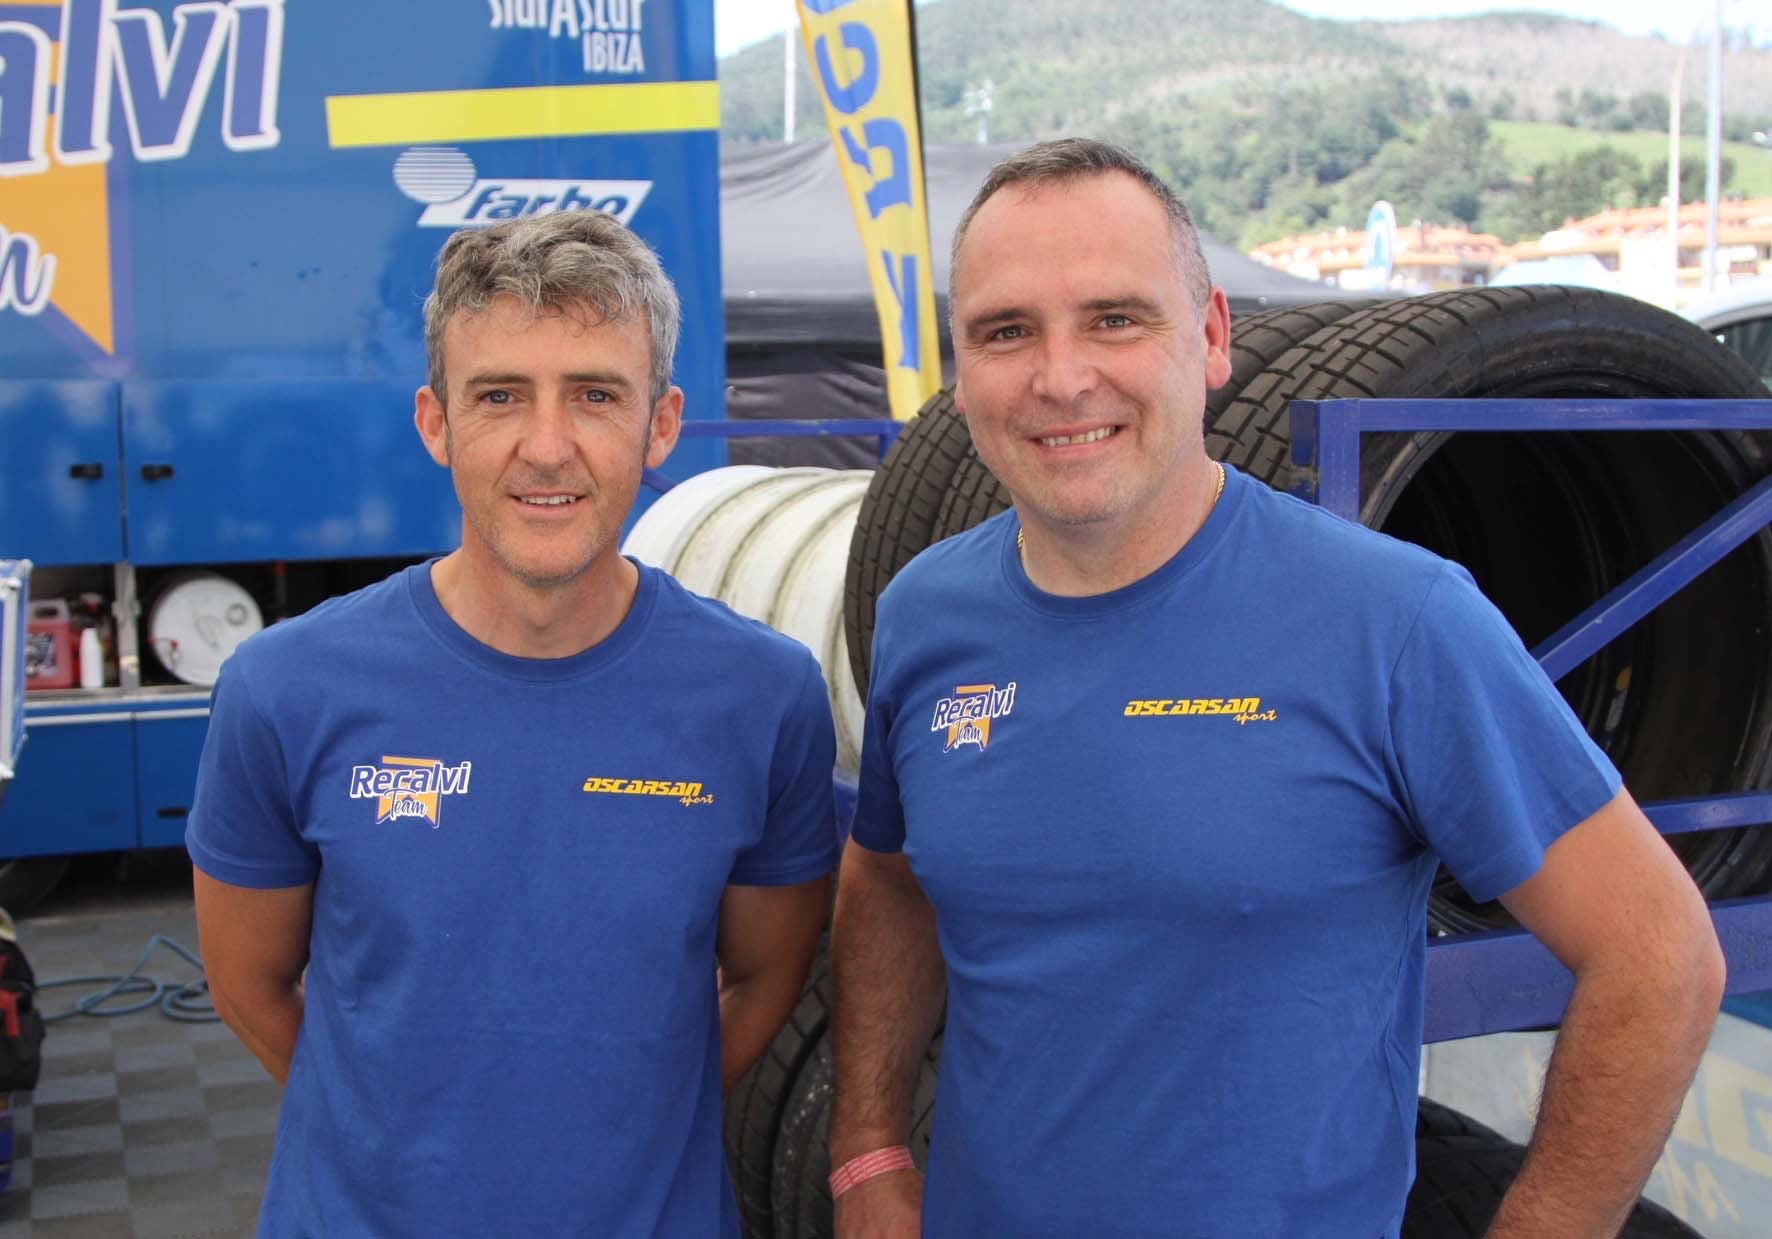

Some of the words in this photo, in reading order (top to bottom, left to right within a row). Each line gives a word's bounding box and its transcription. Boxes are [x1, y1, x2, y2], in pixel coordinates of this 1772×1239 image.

[582, 31, 645, 73] IBIZA
[931, 682, 1016, 732] Recalvi
[1232, 709, 1277, 725] sport
[954, 716, 983, 749] Team
[350, 760, 472, 799] Recalvi
[383, 788, 428, 821] Team
[680, 794, 714, 807] sport
